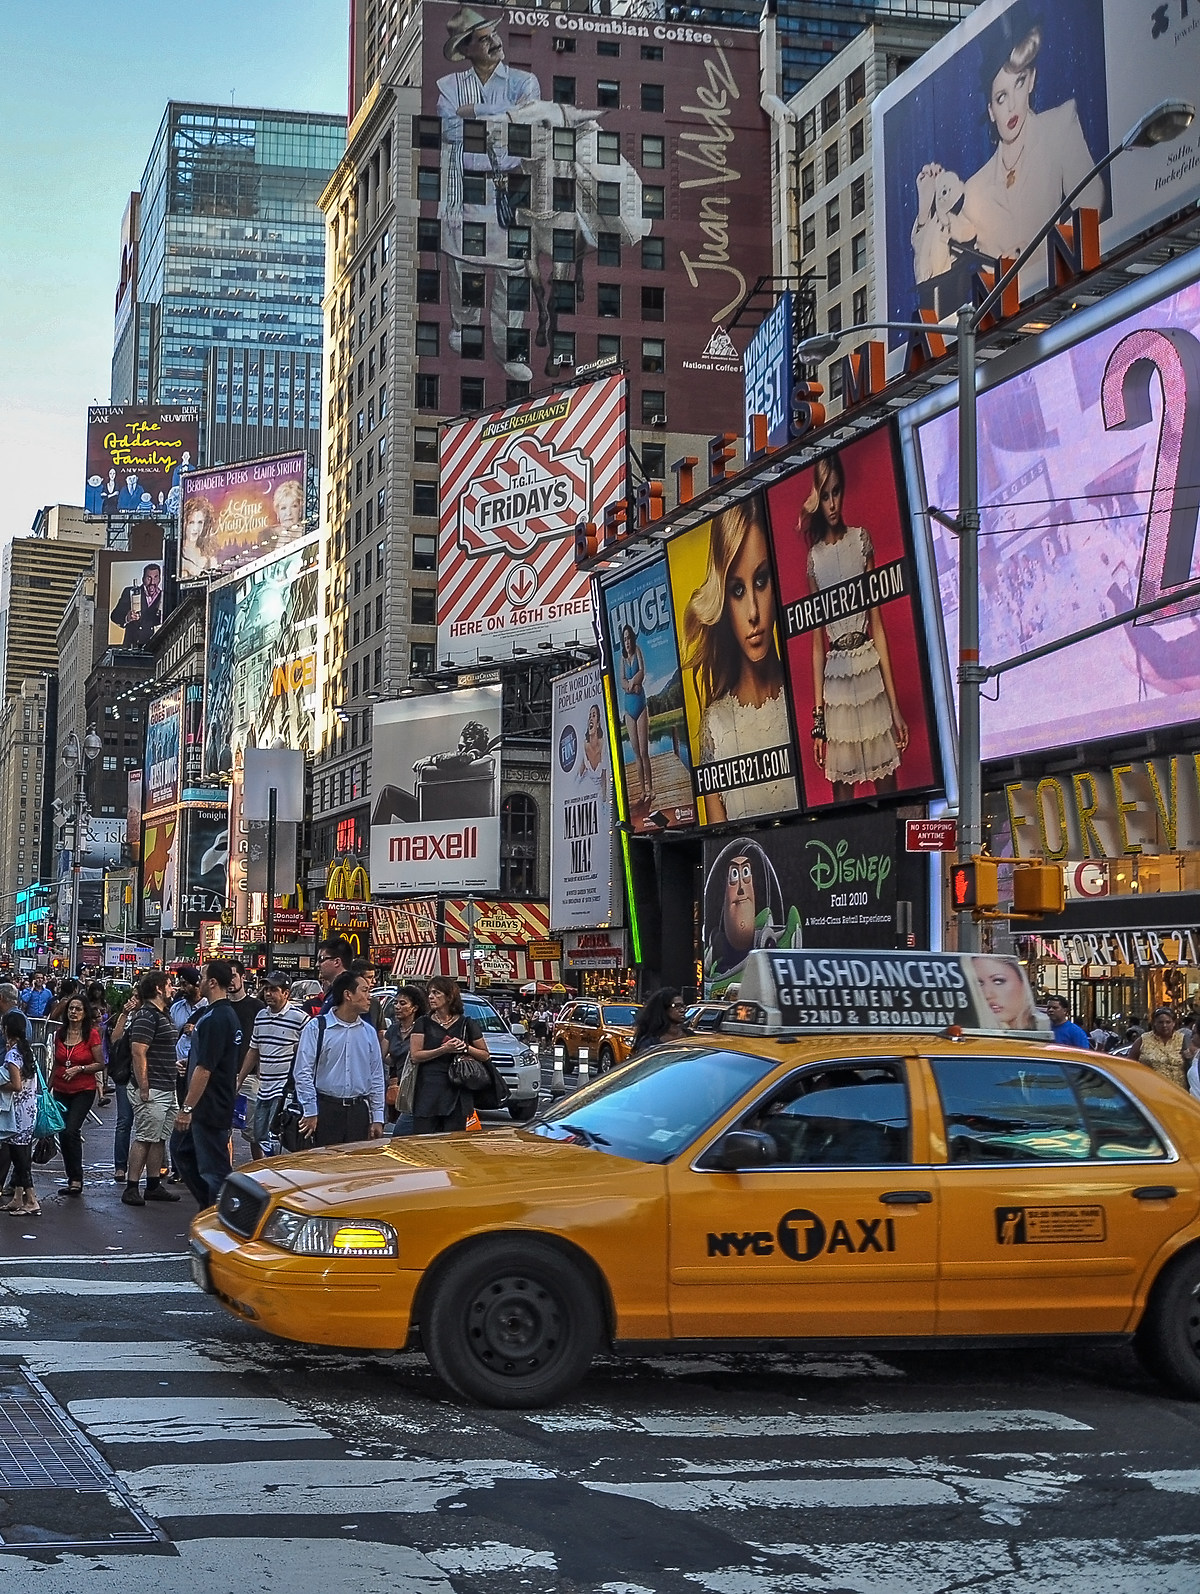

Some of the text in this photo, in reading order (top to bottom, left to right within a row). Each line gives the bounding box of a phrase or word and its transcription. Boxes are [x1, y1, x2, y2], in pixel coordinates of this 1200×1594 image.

[508, 10, 712, 44] 100% Colombian Coffee
[675, 38, 741, 191] Valdez
[680, 196, 746, 323] Juan
[743, 299, 786, 376] WINNER!
[682, 361, 714, 371] National
[715, 364, 739, 373] Coffee
[89, 407, 124, 415] NATHAN
[89, 415, 110, 423] LANE
[182, 406, 198, 414] BEBE
[508, 402, 566, 429] RESTAURANTS
[104, 432, 182, 449] Addams
[125, 421, 161, 434] The
[110, 448, 177, 473] Family
[186, 459, 302, 493] BERNADETTE PETERS ELAINE STRITCH
[511, 474, 535, 489] T.G.I.
[786, 563, 905, 635] FOREVER21.COM
[450, 619, 483, 639] HERE
[487, 615, 506, 632] ON
[509, 608, 544, 626] 46TH
[548, 600, 592, 620] STREE
[611, 583, 671, 647] HUGE
[569, 672, 594, 691] WORLD'S
[558, 682, 602, 710] POPULAR MUSIC
[696, 748, 791, 793] FOREVER21.COM
[197, 810, 227, 821] Tonight
[563, 800, 599, 840] MAMMA
[921, 823, 953, 831] STOPPING
[85, 829, 101, 843] &
[389, 826, 478, 863] maxell
[918, 832, 945, 840] ANYTIME
[570, 837, 592, 875] MIA!
[805, 839, 892, 900] Disney
[830, 892, 868, 908] Fall 2010
[480, 919, 519, 930] FRIDAY'S
[859, 914, 892, 926] Experience
[1059, 930, 1199, 967] FOREVER 21
[772, 958, 966, 989] FLASHDANCERS
[779, 988, 969, 1009] GENTLEMEN'S CLUB
[800, 1010, 956, 1026] 52ND & BROADWAY
[706, 1210, 897, 1259] NYC TAXI
